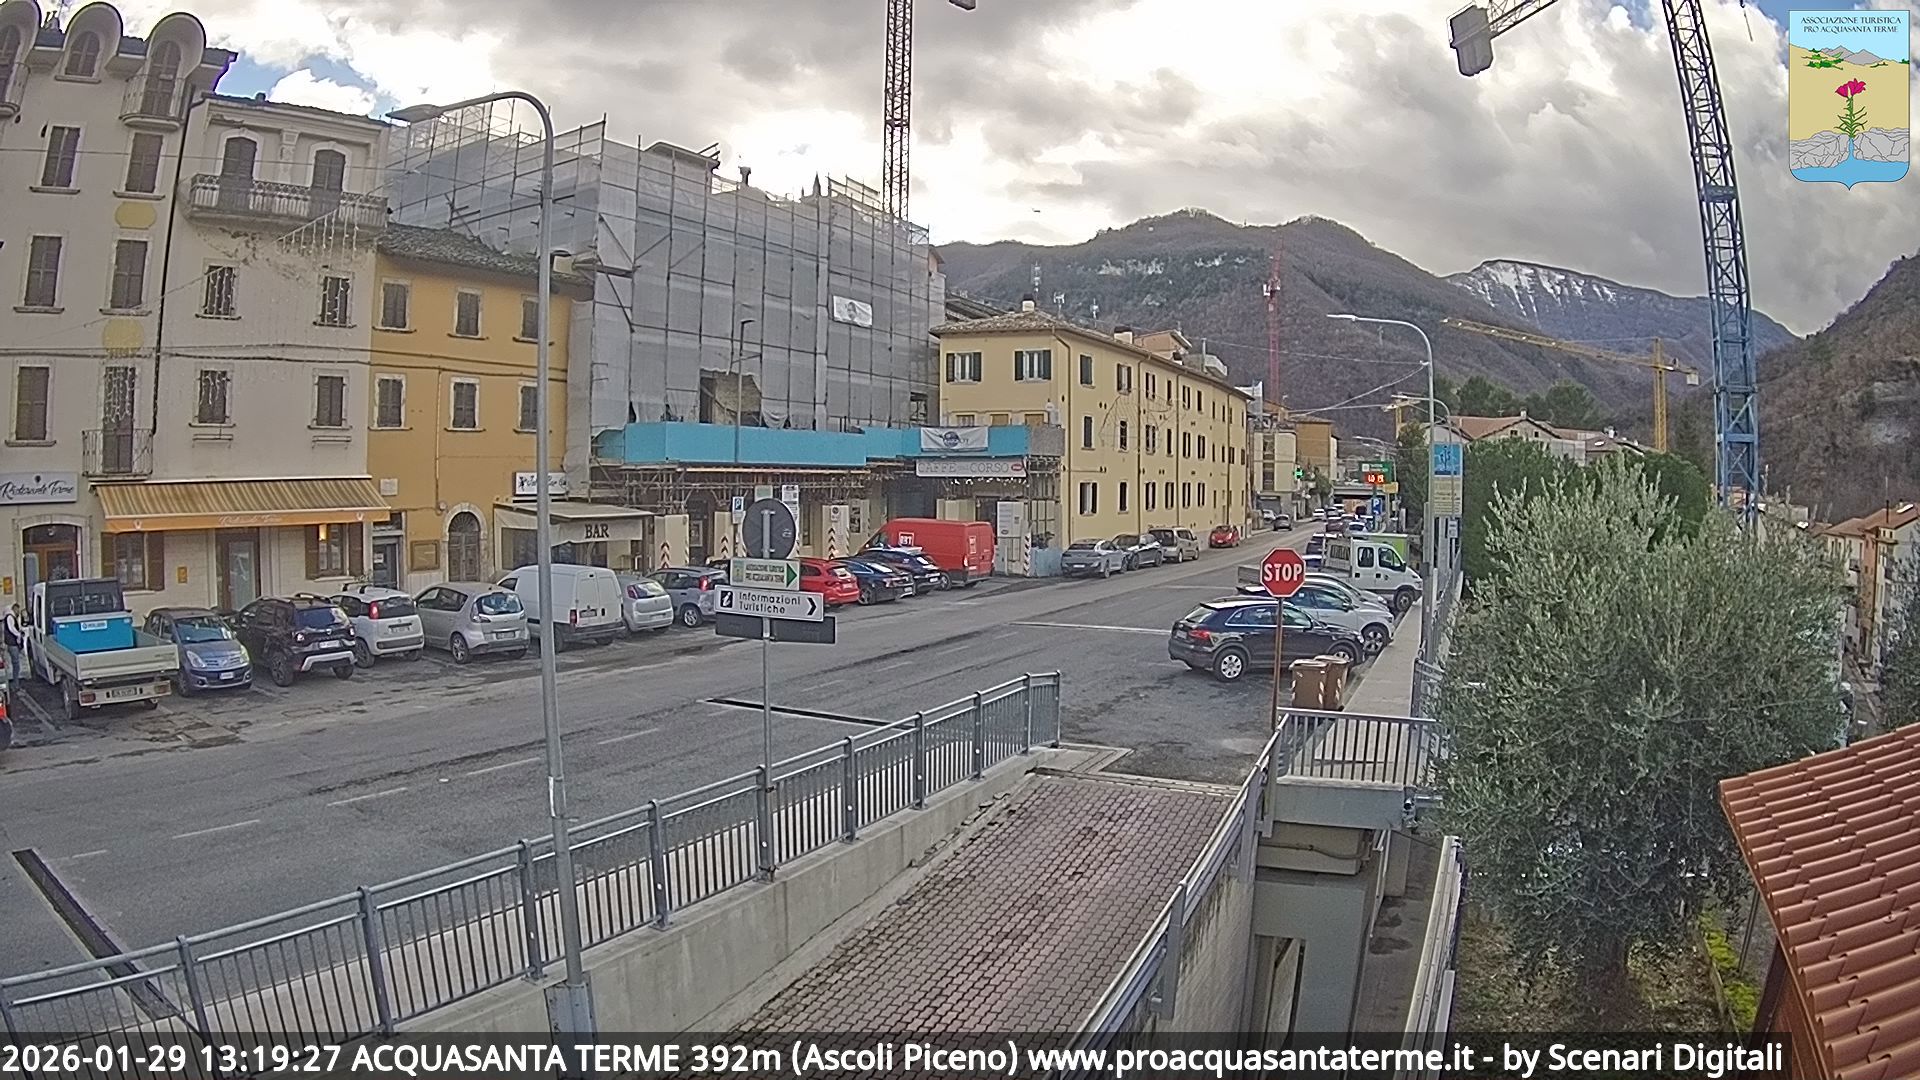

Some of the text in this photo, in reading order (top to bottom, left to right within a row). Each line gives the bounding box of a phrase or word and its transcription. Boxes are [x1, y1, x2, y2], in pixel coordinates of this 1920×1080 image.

[969, 462, 1010, 473] CORSO
[584, 523, 609, 539] BAR
[1263, 563, 1303, 582] STOP
[739, 592, 801, 605] Informazioni
[739, 601, 786, 614] Turistiche
